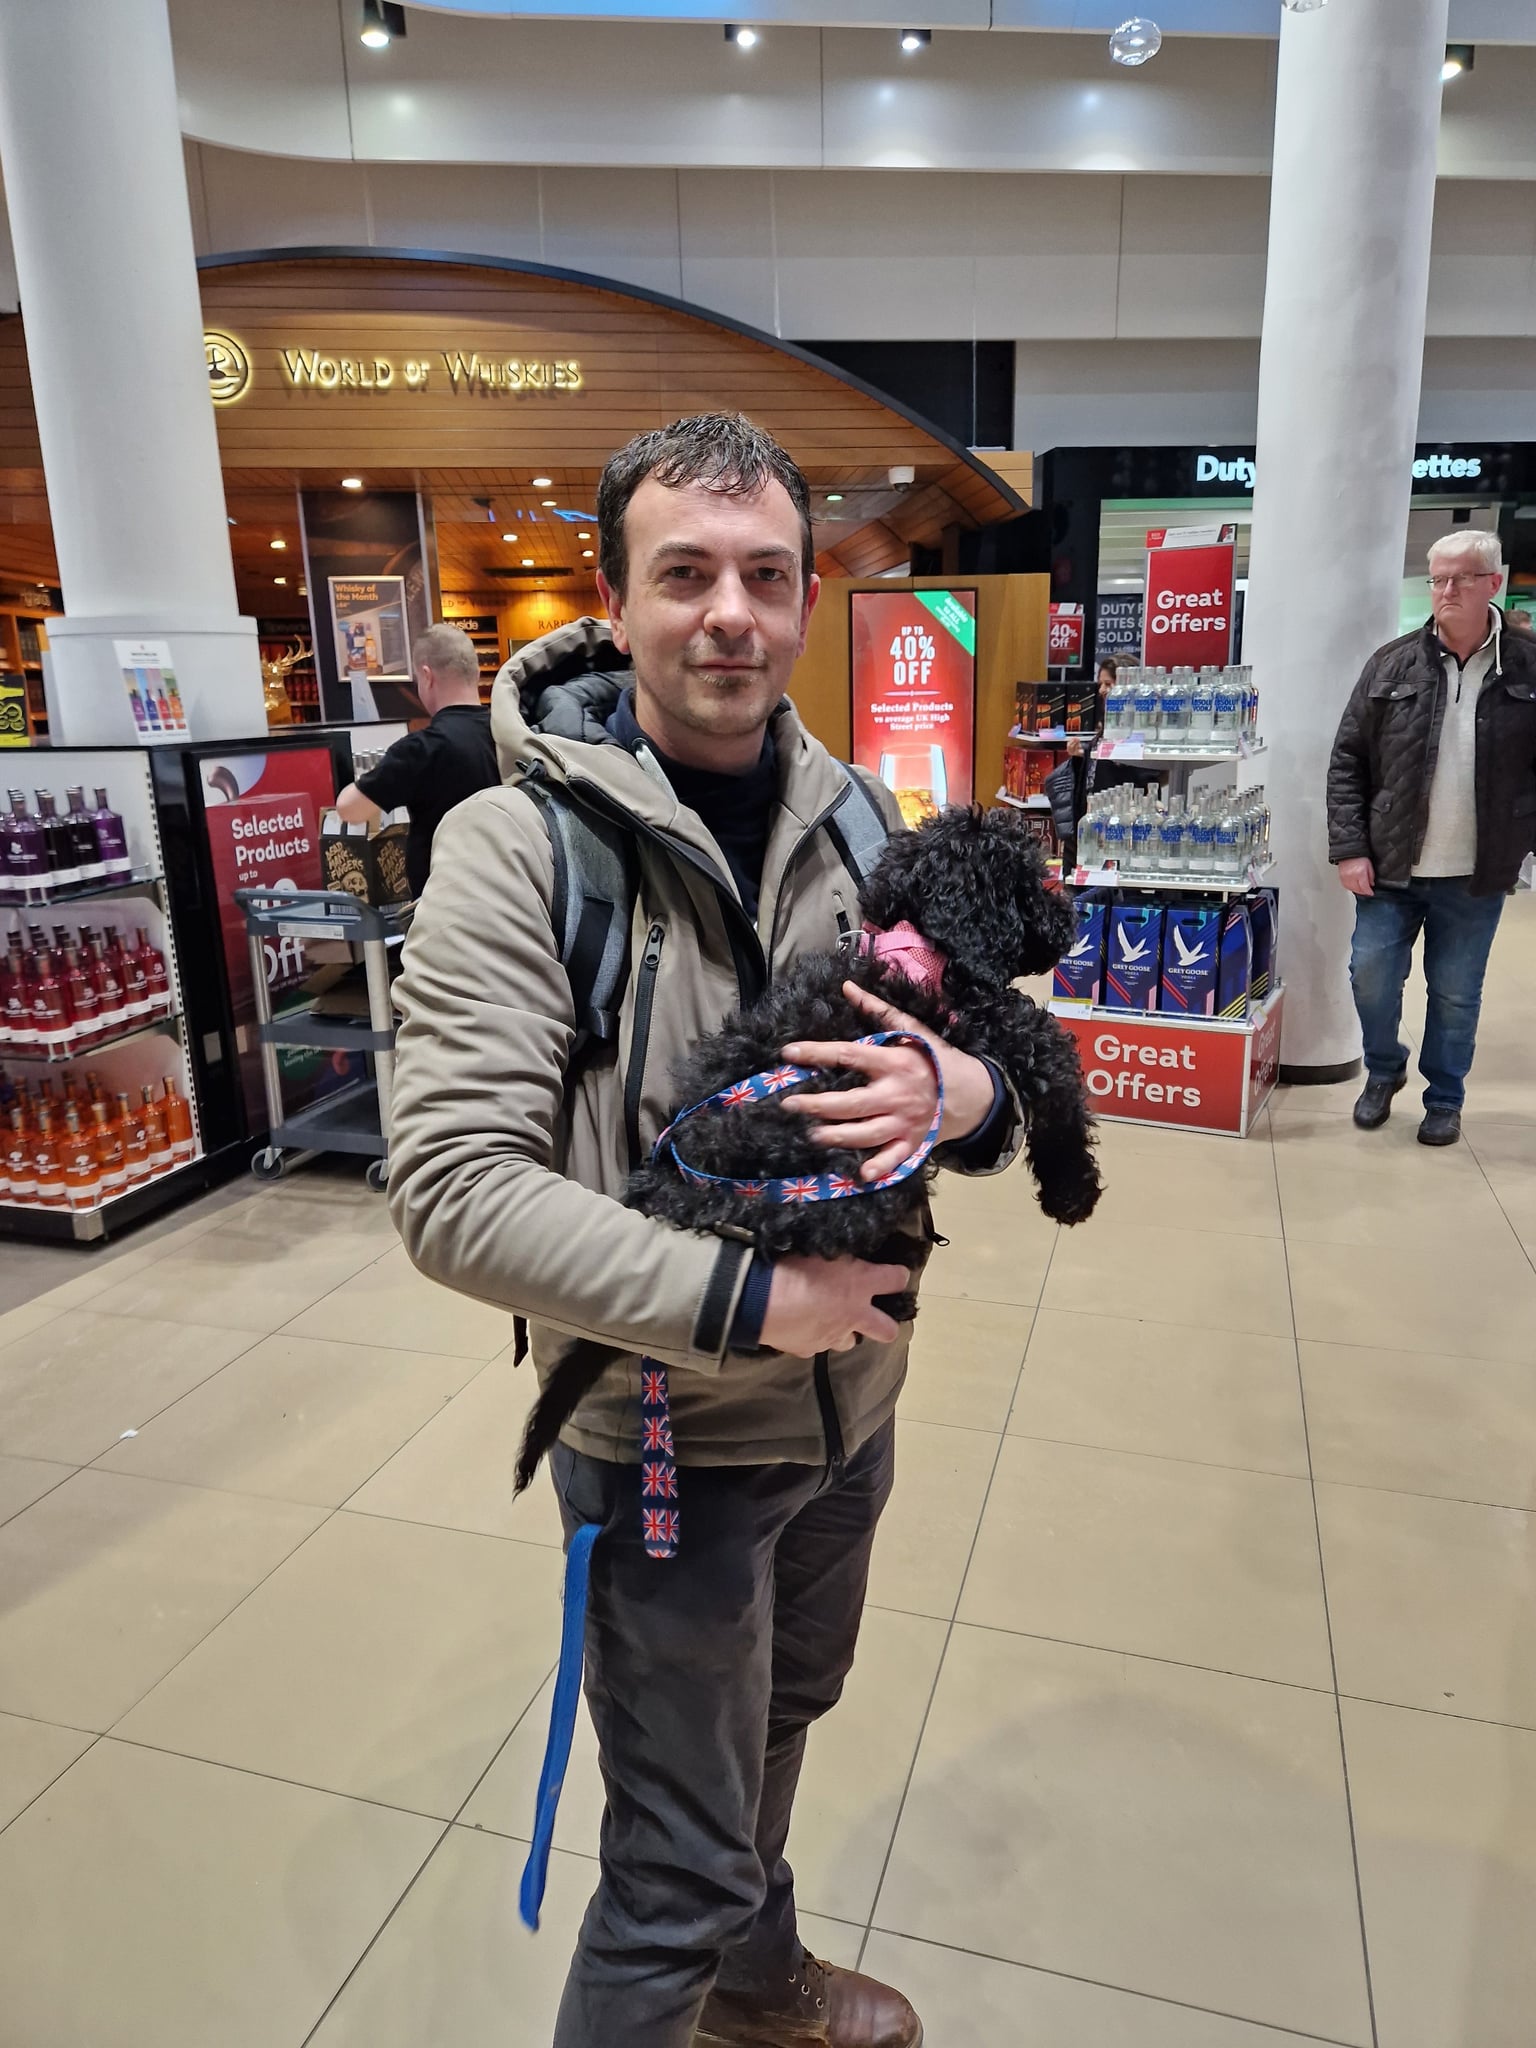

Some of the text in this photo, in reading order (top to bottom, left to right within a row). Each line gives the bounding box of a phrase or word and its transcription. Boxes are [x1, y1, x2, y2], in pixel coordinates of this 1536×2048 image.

[280, 349, 581, 388] WORLD OF WHISKIES
[1196, 454, 1257, 489] Duty
[1412, 455, 1481, 479] ettes
[335, 584, 376, 594] Whisky of
[336, 593, 378, 601] the Month
[1156, 589, 1223, 609] Great
[1101, 603, 1136, 615] DUTY
[901, 625, 924, 636] UP TO
[1097, 618, 1136, 630] ETTES
[1151, 613, 1227, 634] Offers
[1050, 624, 1079, 639] 40%
[1097, 632, 1134, 643] SOLD
[889, 635, 936, 660] 40%
[1050, 638, 1071, 648] Off
[893, 661, 933, 686] OFF
[870, 701, 954, 714] Selected Products
[884, 716, 915, 724] average
[930, 713, 951, 724] High
[231, 808, 304, 840] Selected
[235, 837, 311, 868] Products
[239, 869, 258, 882] up to
[330, 859, 364, 880] FINGERS
[1073, 959, 1094, 967] GOOSE
[1112, 963, 1151, 973] GREY GOOSE
[1185, 968, 1208, 976] GOOSE
[1094, 1034, 1197, 1070] Great
[1087, 1069, 1201, 1108] Offers
